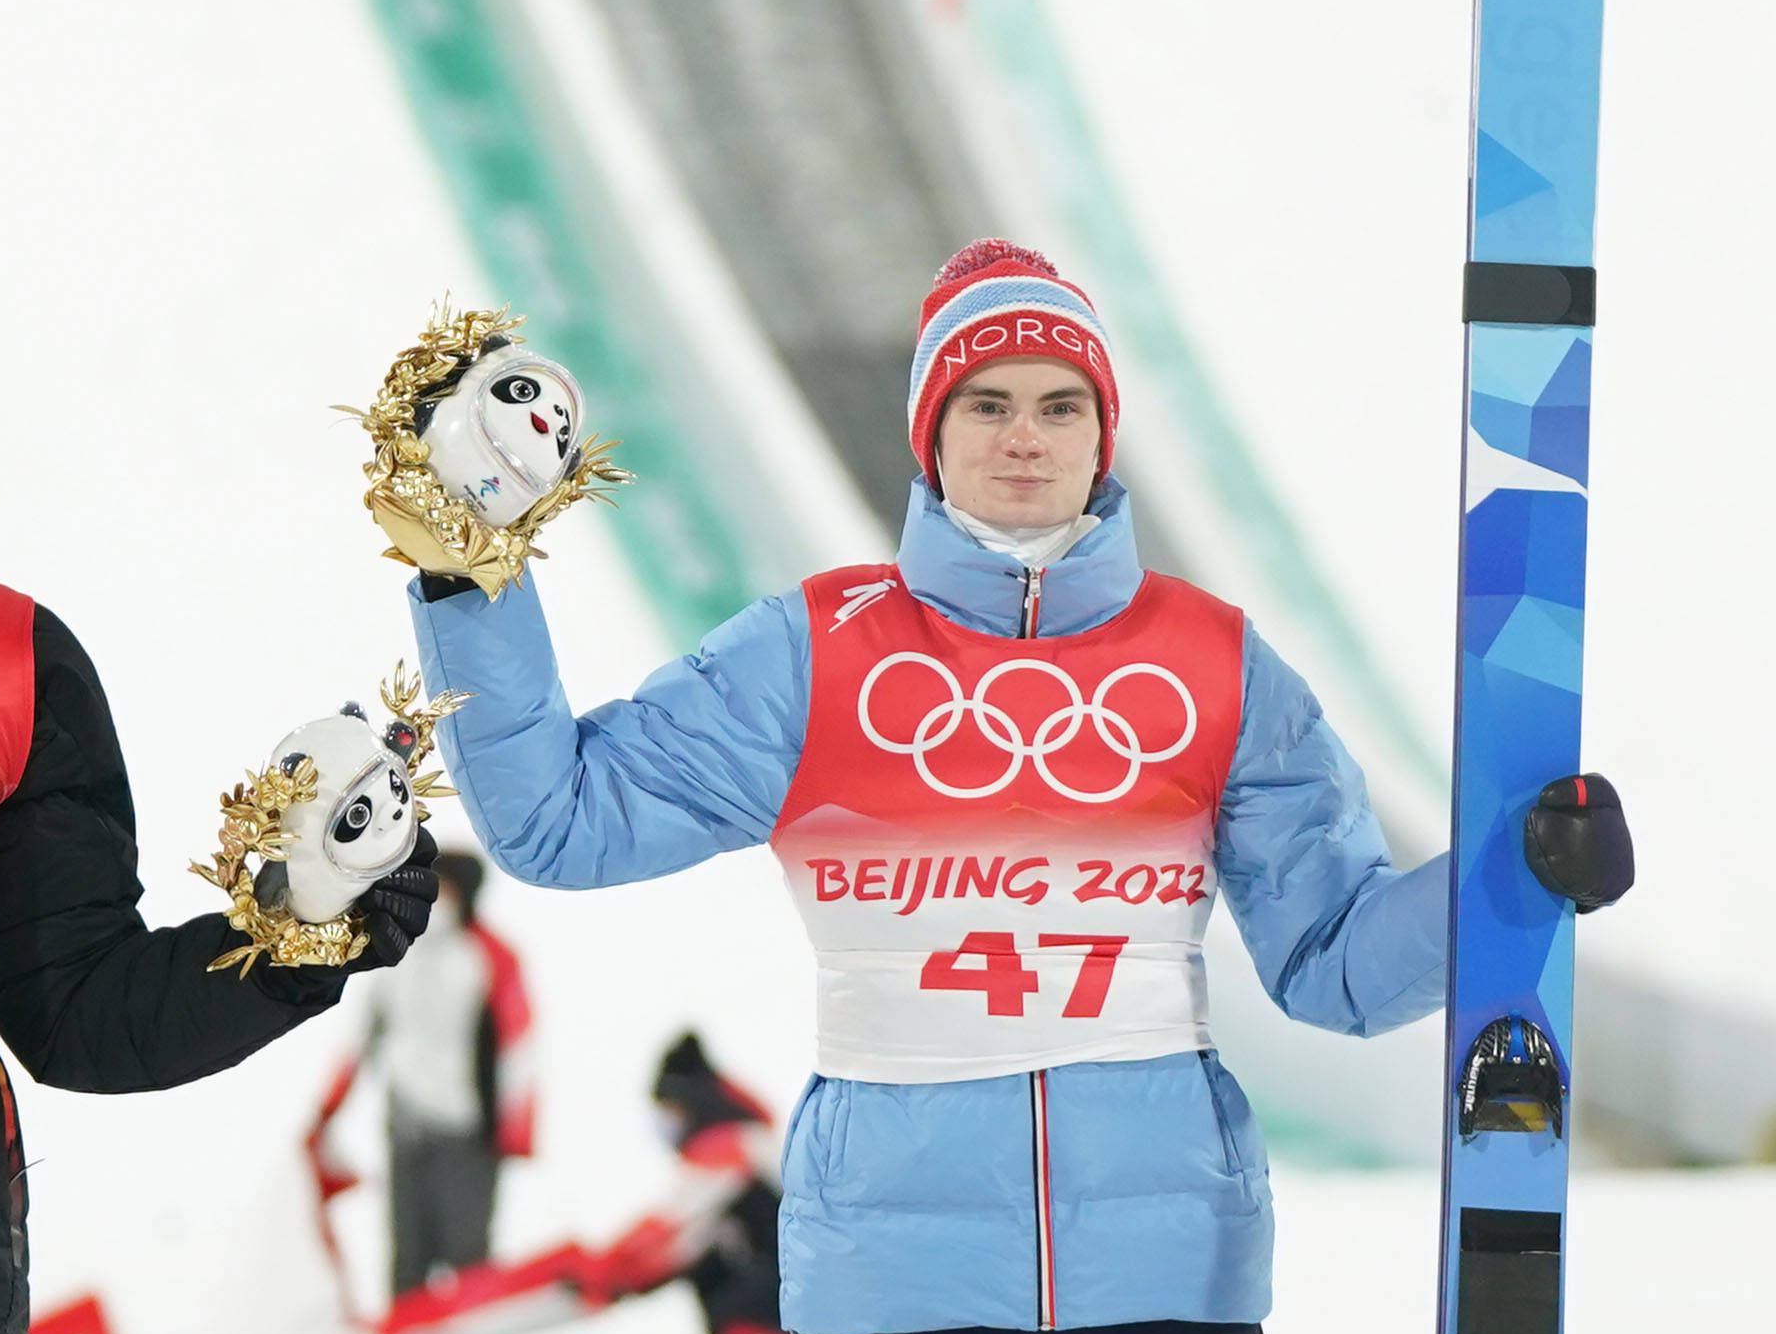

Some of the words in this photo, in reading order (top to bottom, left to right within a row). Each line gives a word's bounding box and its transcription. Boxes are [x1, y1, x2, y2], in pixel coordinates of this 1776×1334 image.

[943, 318, 1102, 380] NORGE
[804, 855, 1051, 917] BEIJING
[1072, 859, 1209, 907] 2022
[918, 930, 1131, 1019] 47
